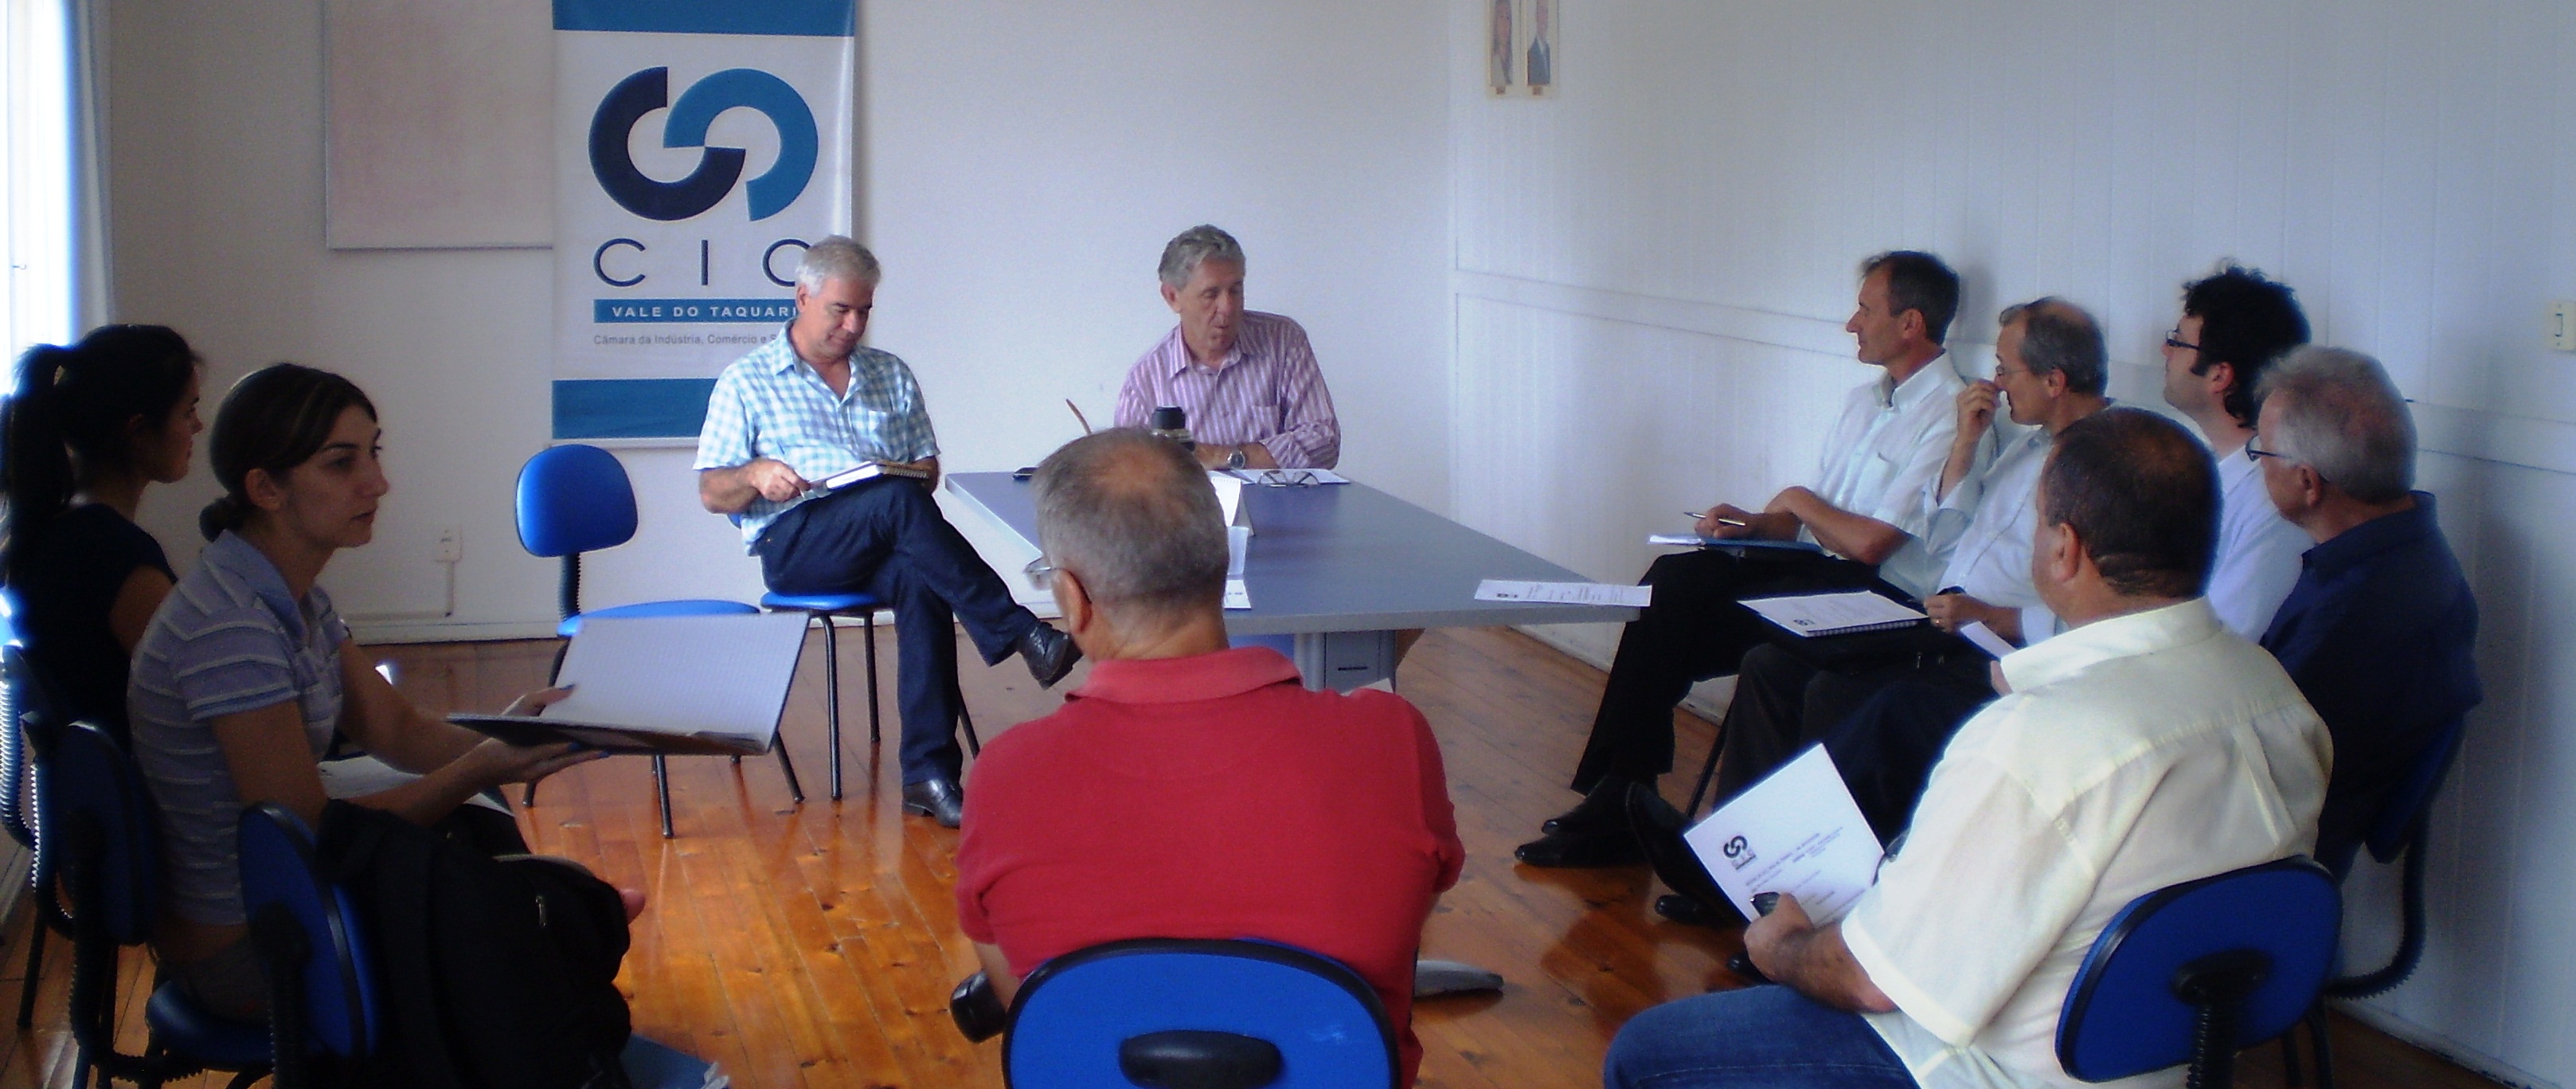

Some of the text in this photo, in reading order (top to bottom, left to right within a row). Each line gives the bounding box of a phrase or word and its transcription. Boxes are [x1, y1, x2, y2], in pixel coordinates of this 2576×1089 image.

[612, 306, 797, 318] VALE DO TAQUARI
[593, 335, 635, 345] Câmara
[638, 335, 651, 345] da
[707, 334, 758, 344] Comércio
